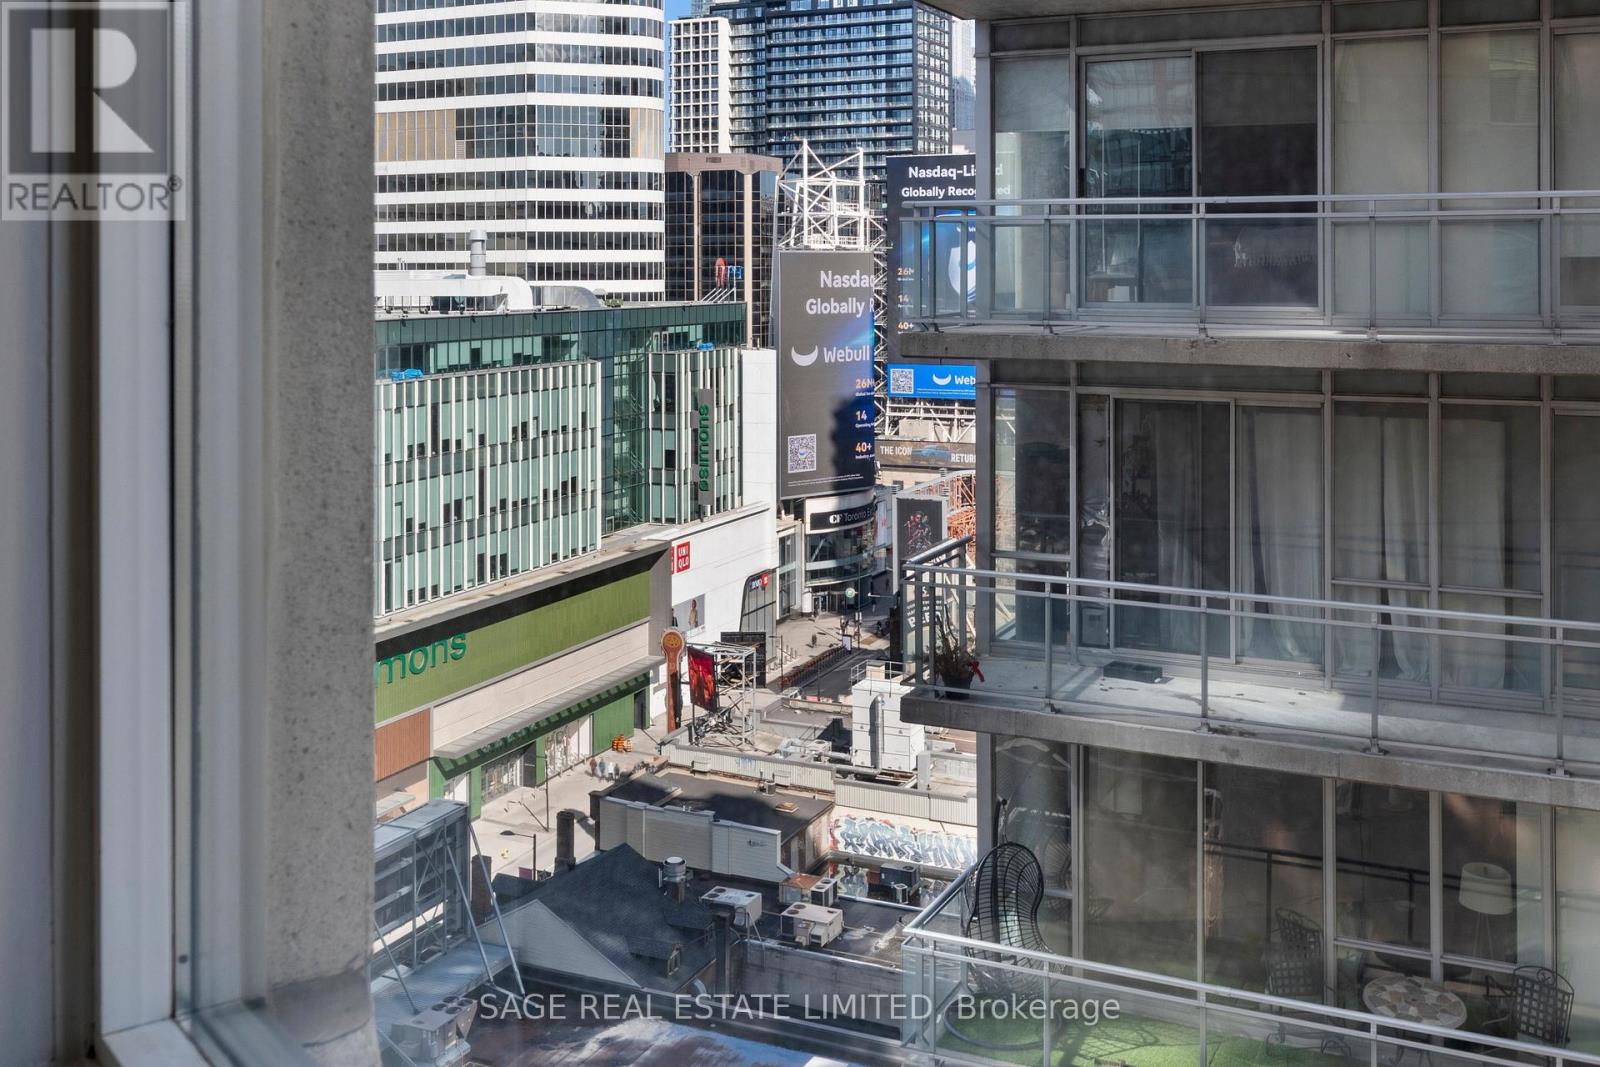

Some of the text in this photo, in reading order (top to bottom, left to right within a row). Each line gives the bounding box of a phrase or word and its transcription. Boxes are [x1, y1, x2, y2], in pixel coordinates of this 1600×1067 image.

[908, 164, 1003, 180] Nasdaq-Lid
[901, 186, 945, 199] Globally
[805, 297, 866, 318] Globally
[823, 344, 870, 363] Webull
[855, 410, 868, 421] 14
[855, 442, 872, 453] 40+
[880, 446, 894, 455] THE
[895, 447, 912, 456] ICON
[829, 513, 843, 524] CF
[678, 545, 689, 557] UNI
[678, 556, 689, 569] QLO
